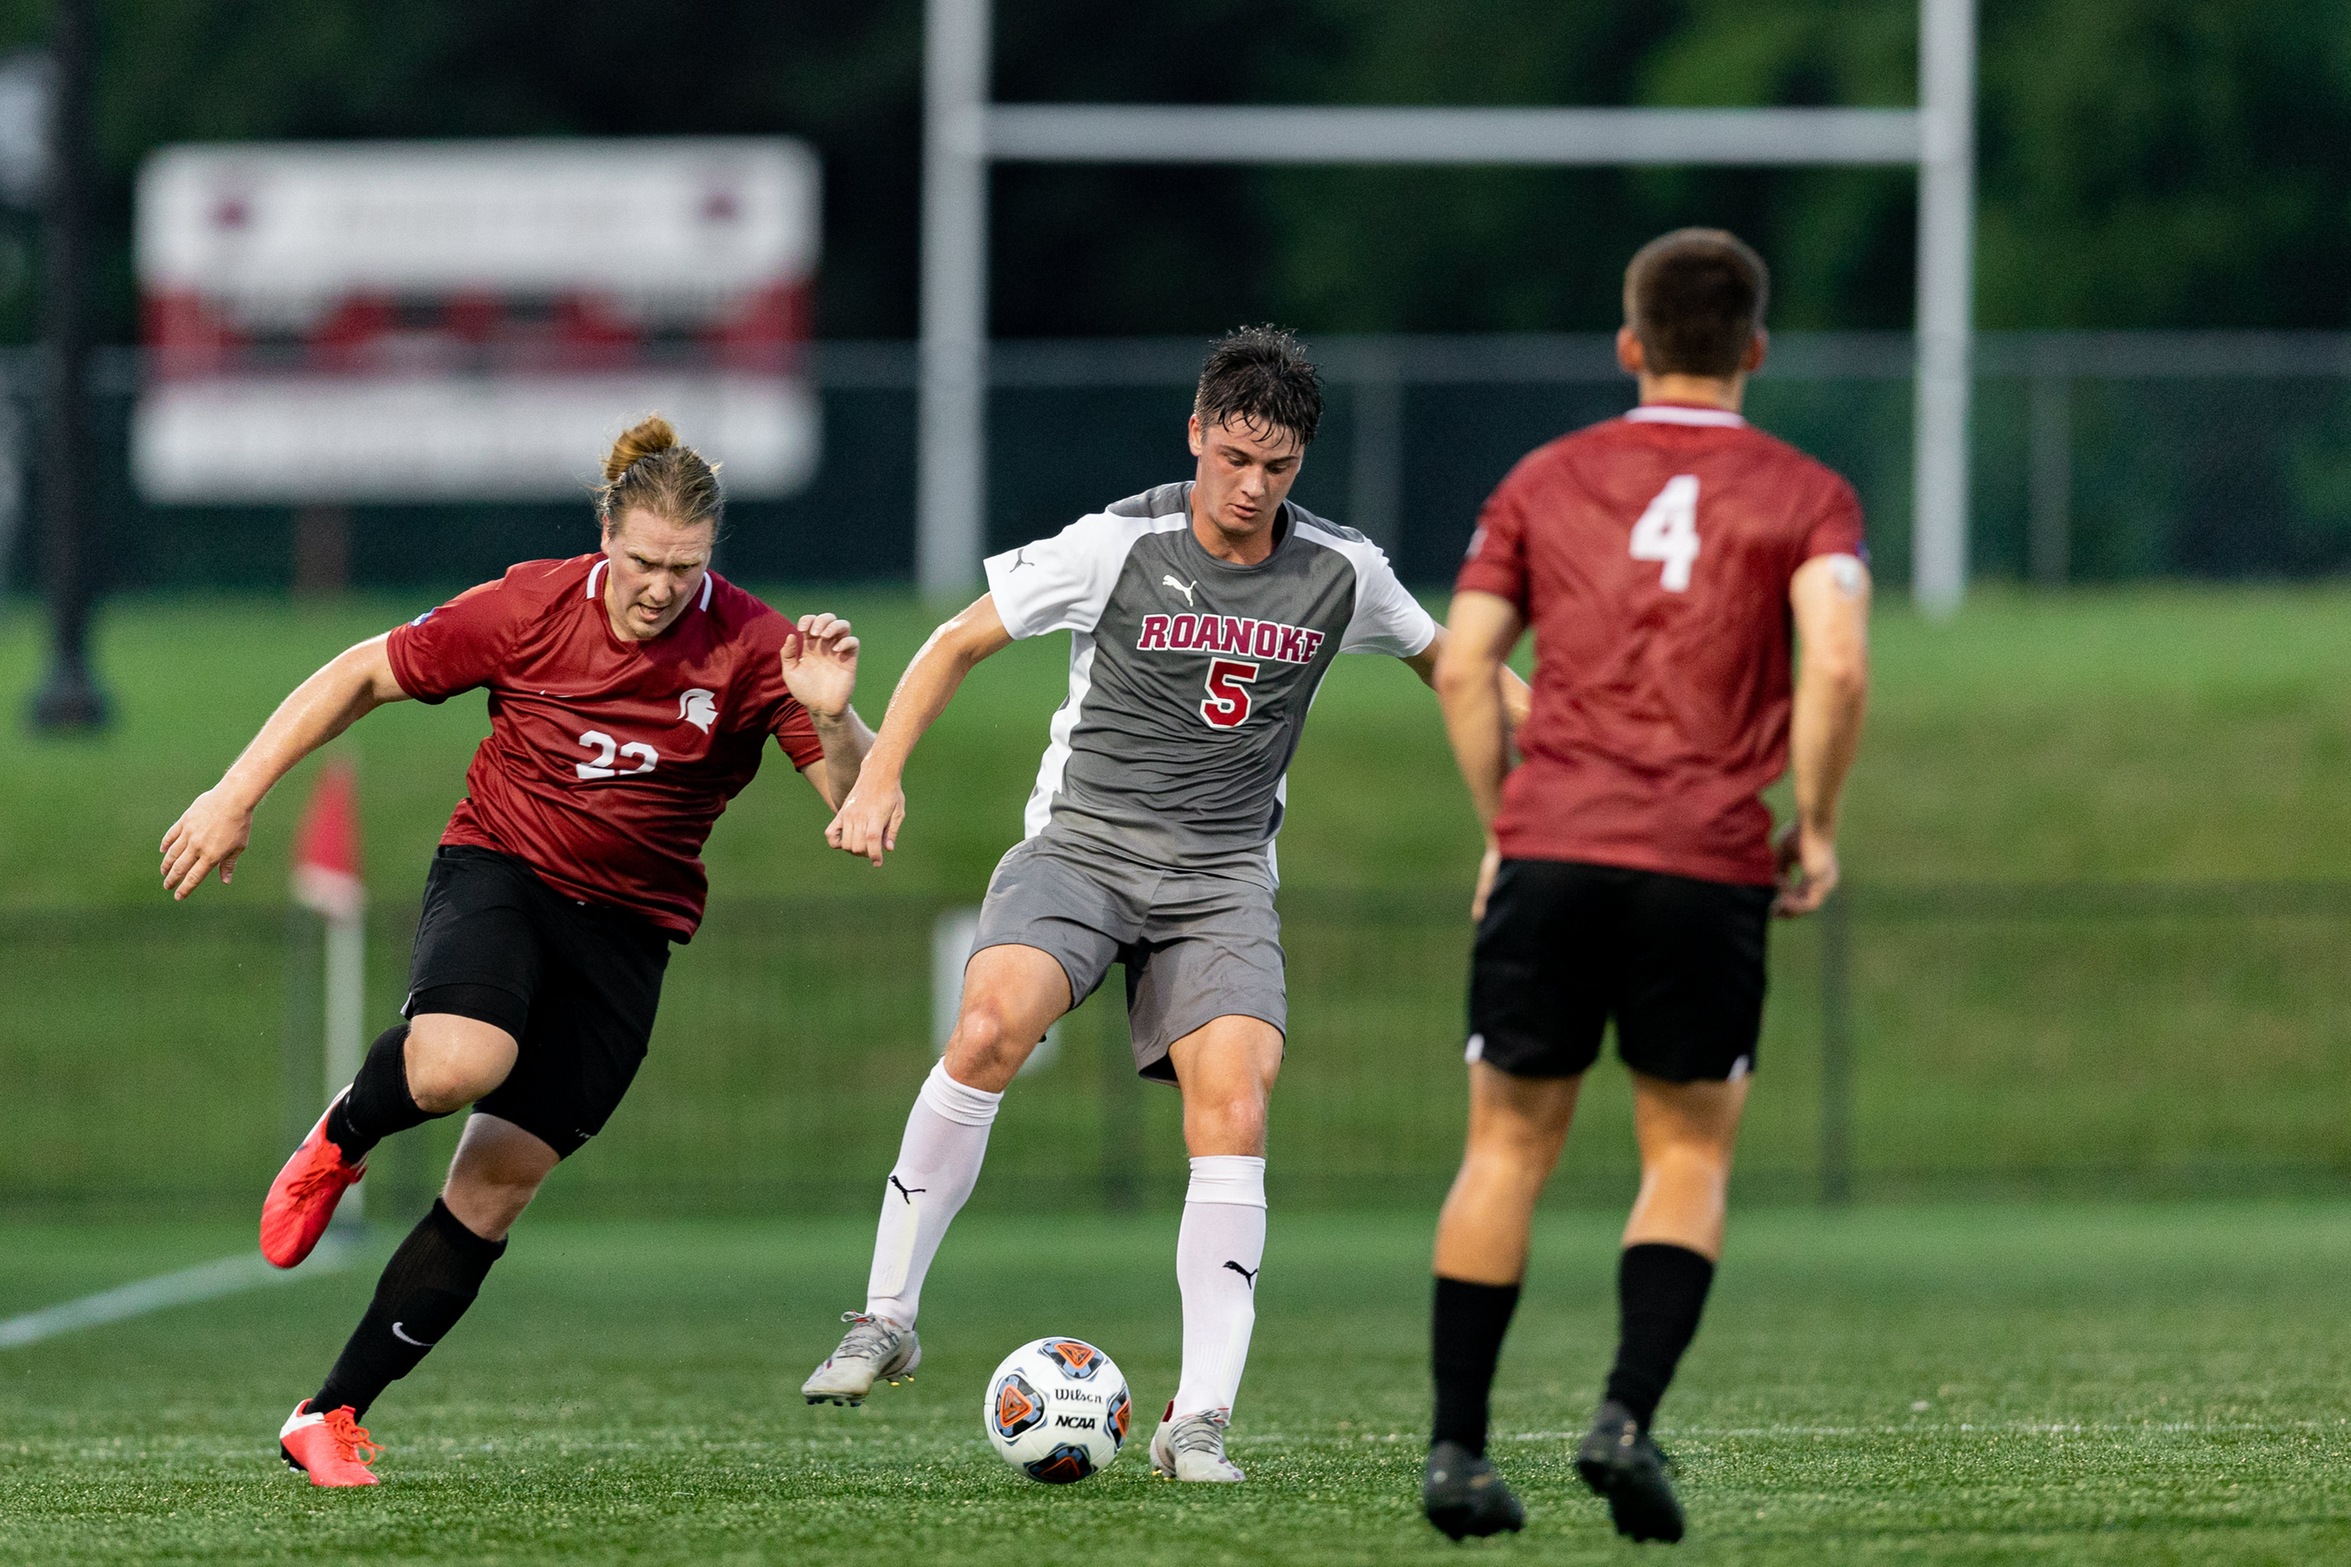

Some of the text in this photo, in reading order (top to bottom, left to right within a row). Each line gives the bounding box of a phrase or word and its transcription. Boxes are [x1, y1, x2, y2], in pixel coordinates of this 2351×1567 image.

[1629, 474, 1701, 593] 4
[1136, 613, 1325, 665] ROANOKE
[1200, 657, 1260, 729] 5
[576, 730, 660, 780] 22
[1055, 1388, 1102, 1404] Wilson
[1055, 1415, 1096, 1430] NCAA
